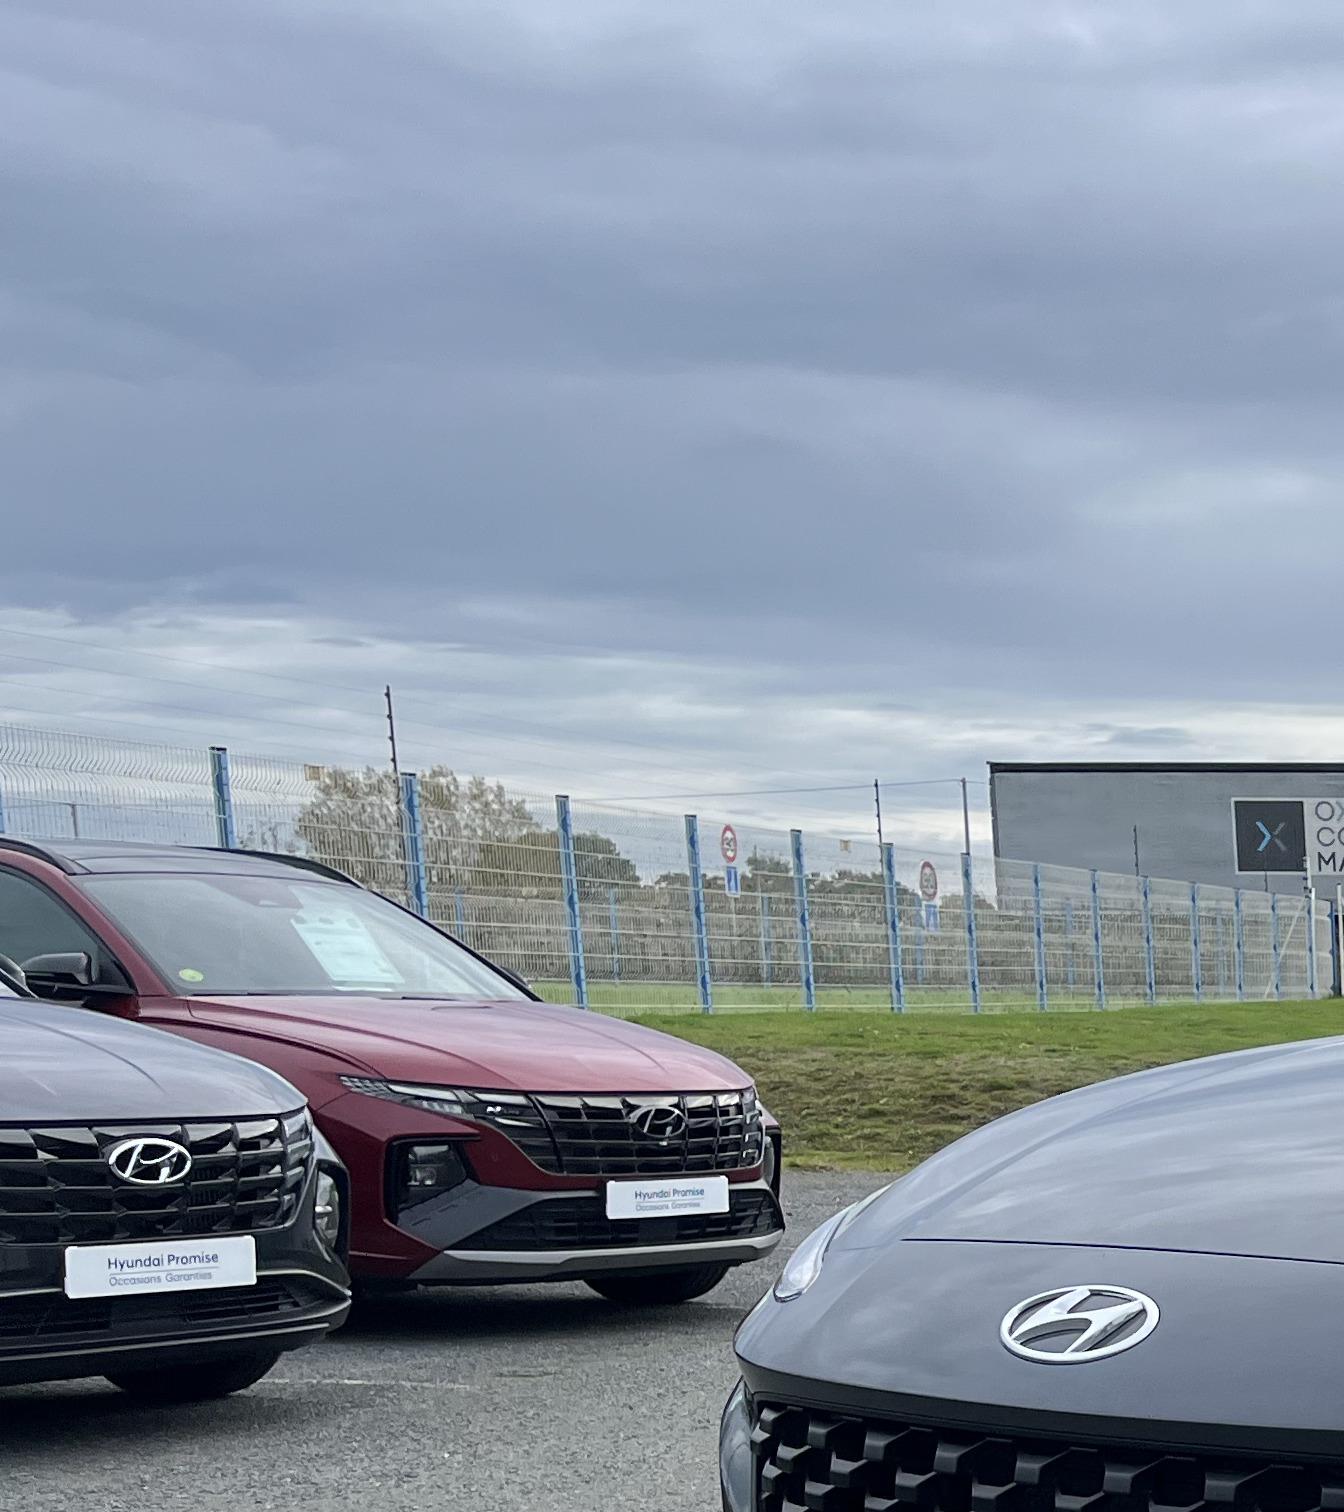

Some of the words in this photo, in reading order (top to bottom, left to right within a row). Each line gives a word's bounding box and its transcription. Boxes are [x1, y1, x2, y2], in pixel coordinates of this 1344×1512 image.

[634, 1189, 671, 1200] Hyundai
[672, 1187, 704, 1197] Promise
[107, 1254, 164, 1271] Hyundai
[167, 1251, 218, 1265] Promise
[109, 1274, 161, 1287] Occasions
